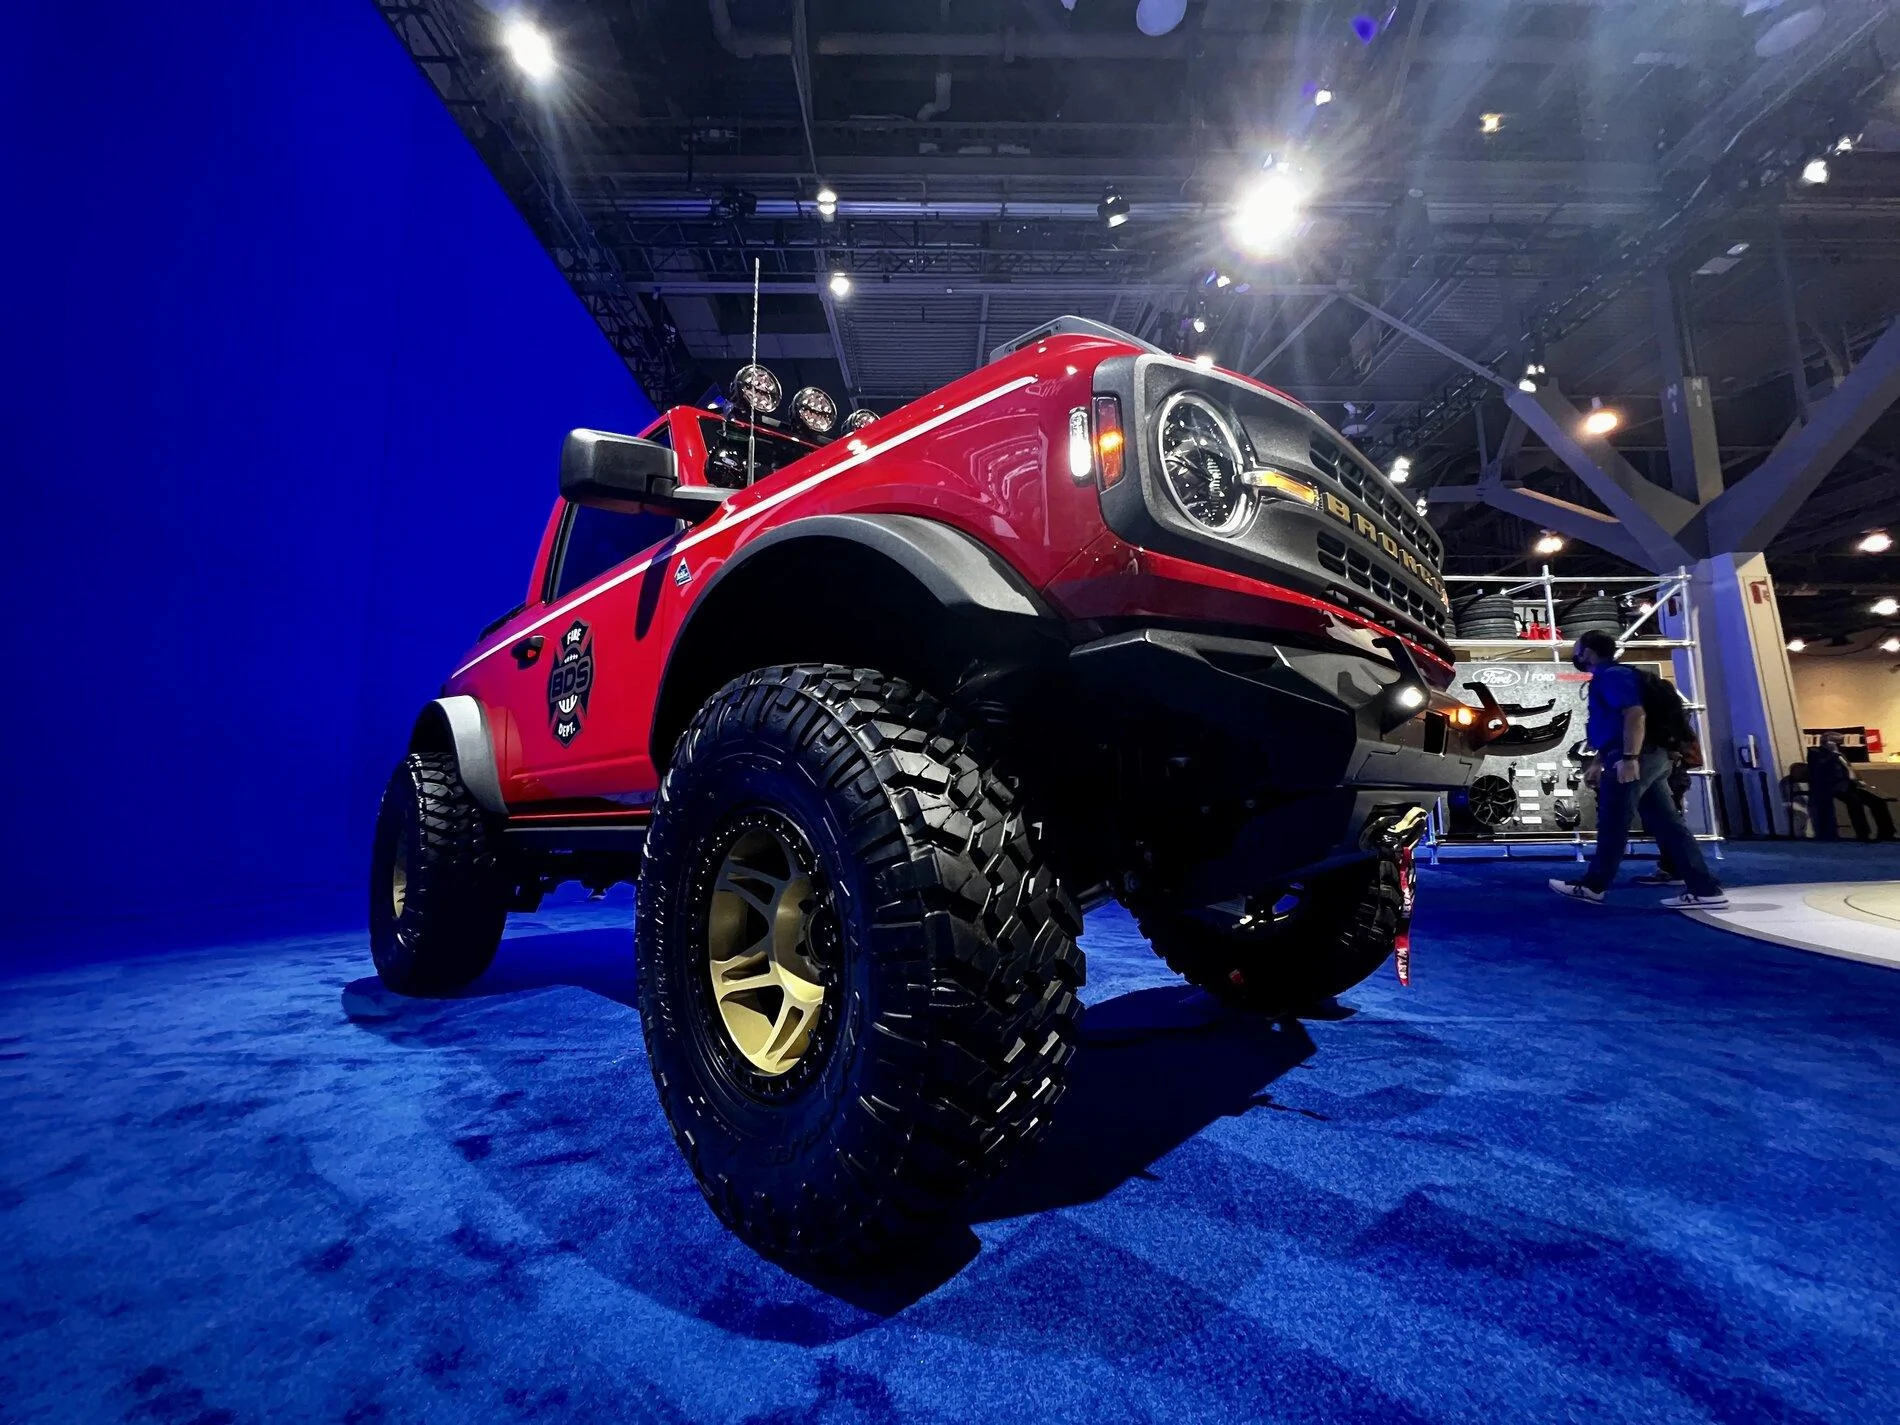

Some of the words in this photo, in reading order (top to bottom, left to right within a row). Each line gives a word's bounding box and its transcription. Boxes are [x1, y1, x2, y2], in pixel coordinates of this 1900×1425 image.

[1322, 491, 1444, 596] BRONCO
[566, 628, 582, 645] FIRE
[551, 657, 591, 699] BDS
[1531, 673, 1556, 682] FORD
[1397, 947, 1408, 979] WARN
